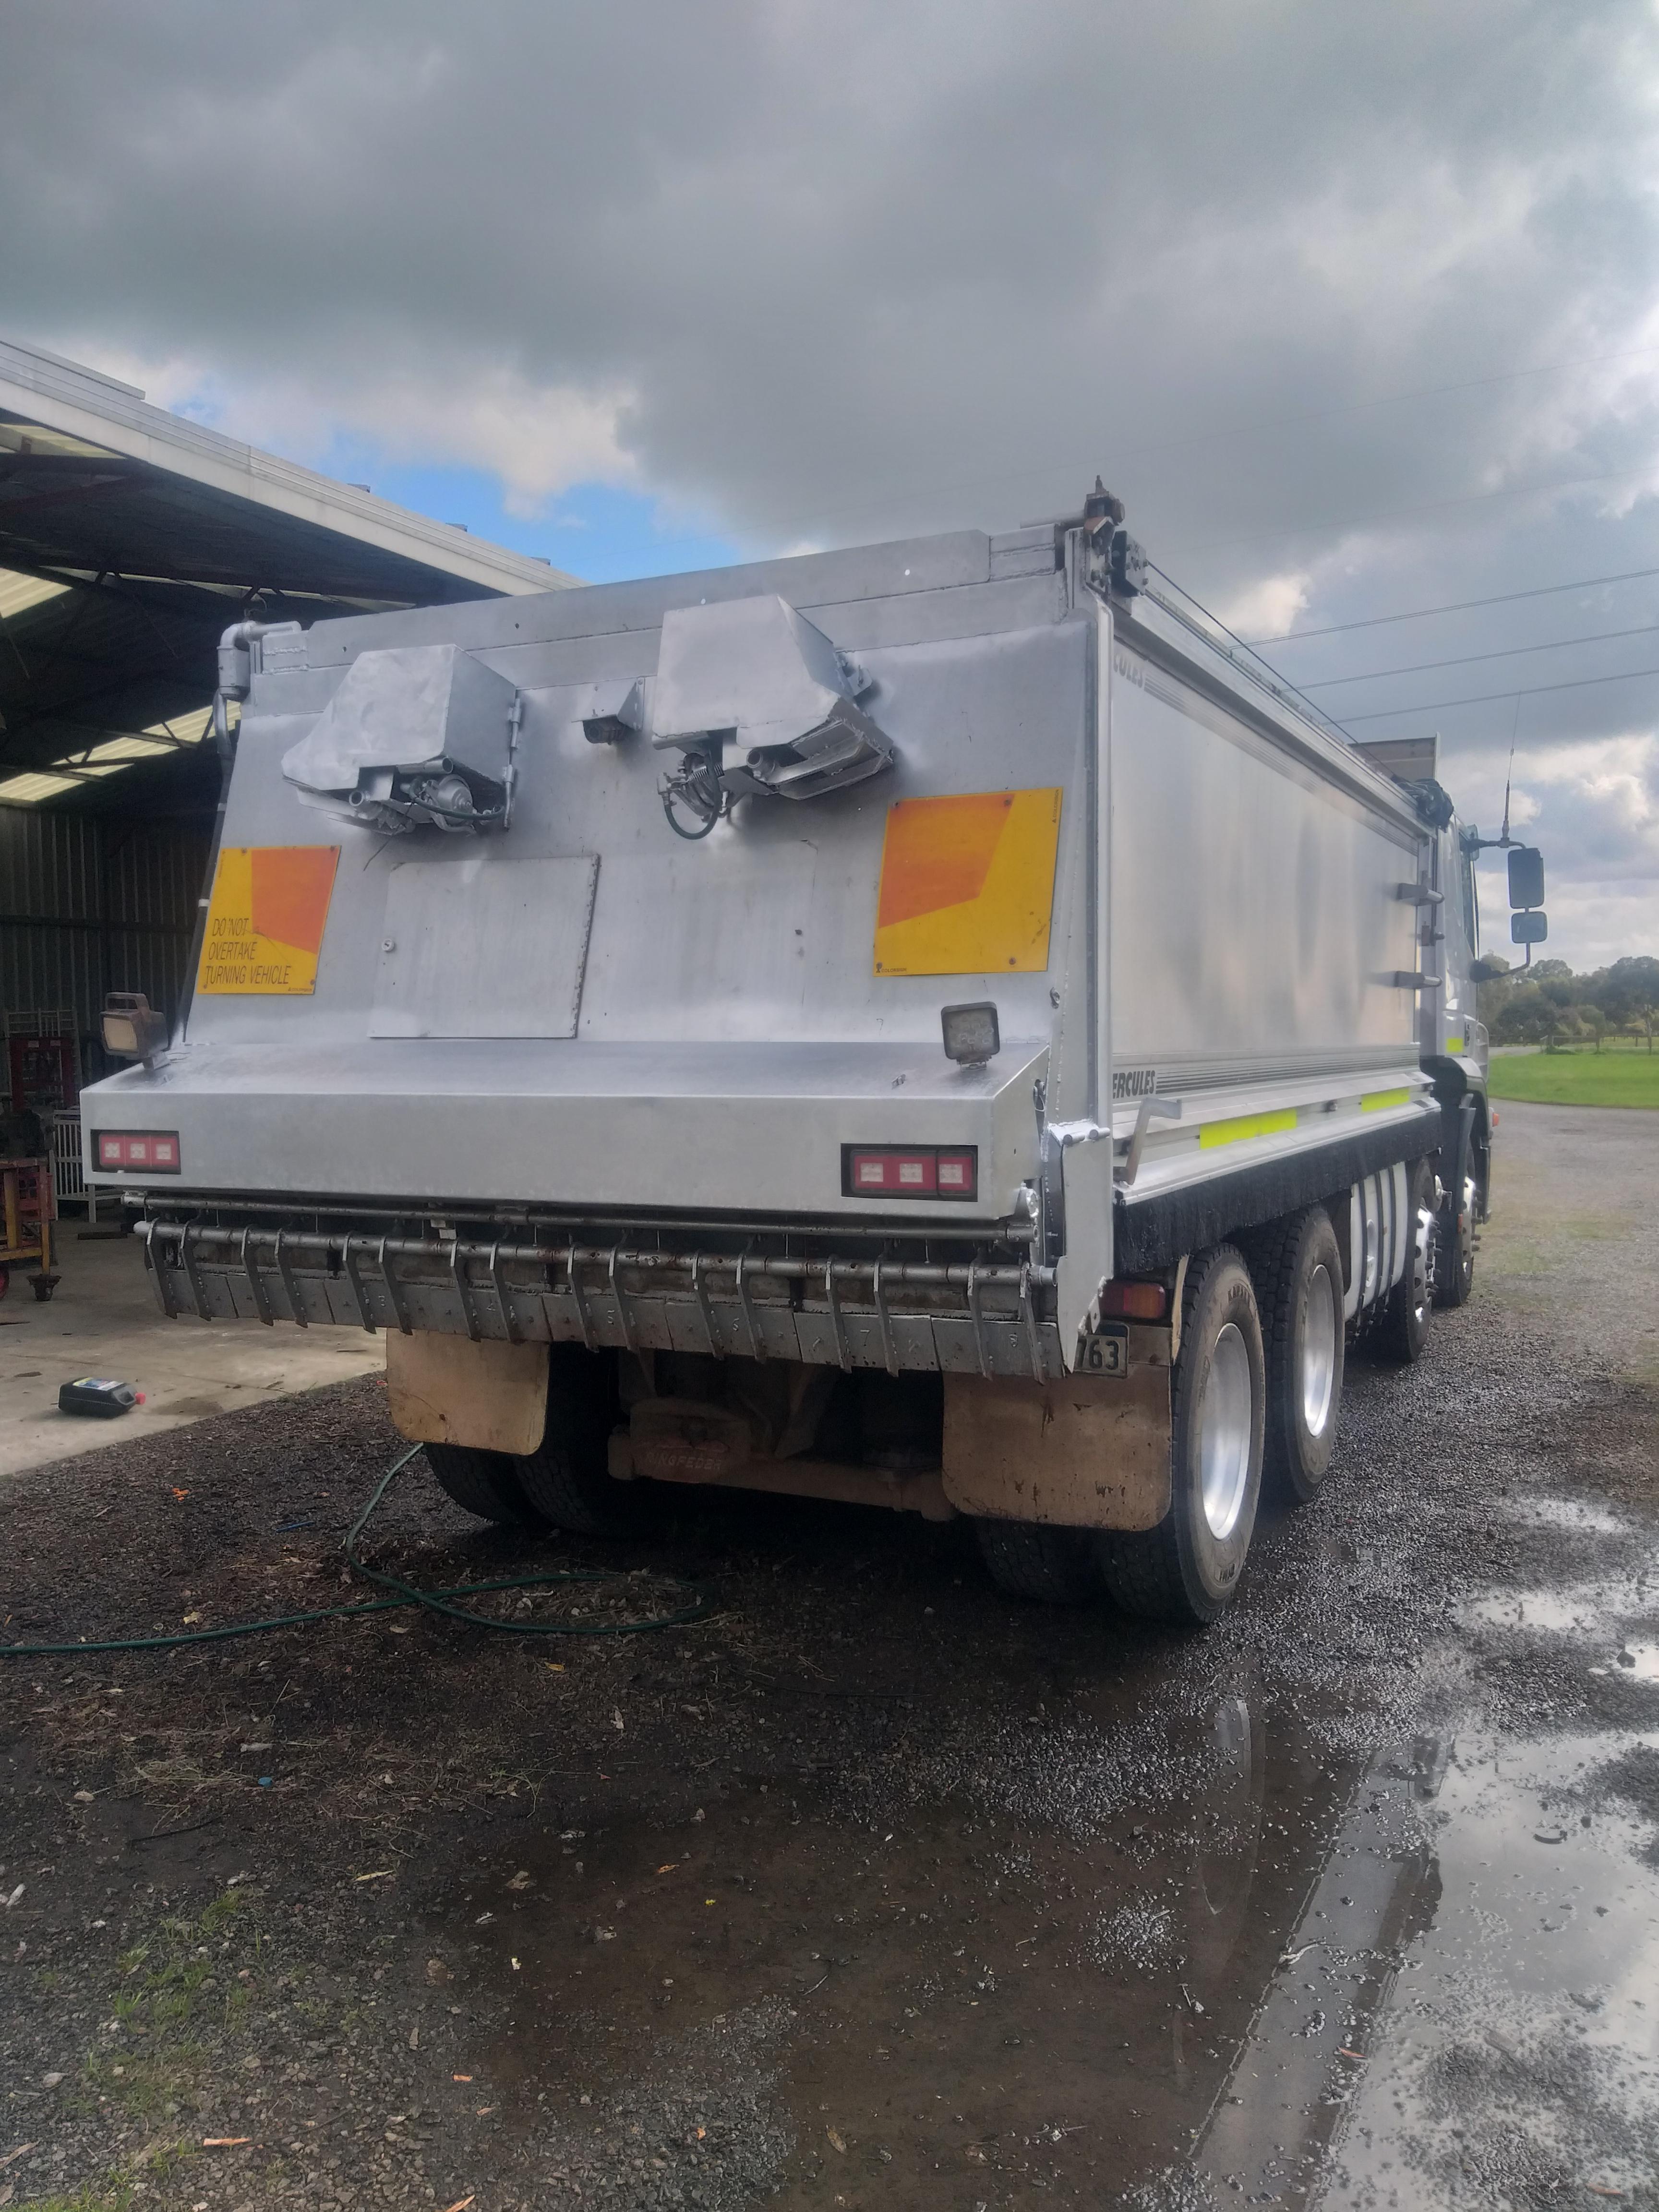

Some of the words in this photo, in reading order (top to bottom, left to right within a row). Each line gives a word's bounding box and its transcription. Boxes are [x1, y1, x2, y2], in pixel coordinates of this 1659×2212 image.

[212, 918, 227, 936] DO
[228, 917, 249, 936] NOT
[208, 942, 257, 960] OVERTAKE
[205, 965, 247, 984] TURNING
[250, 965, 291, 984] VEHICLE
[1113, 1070, 1155, 1099] ERCULES
